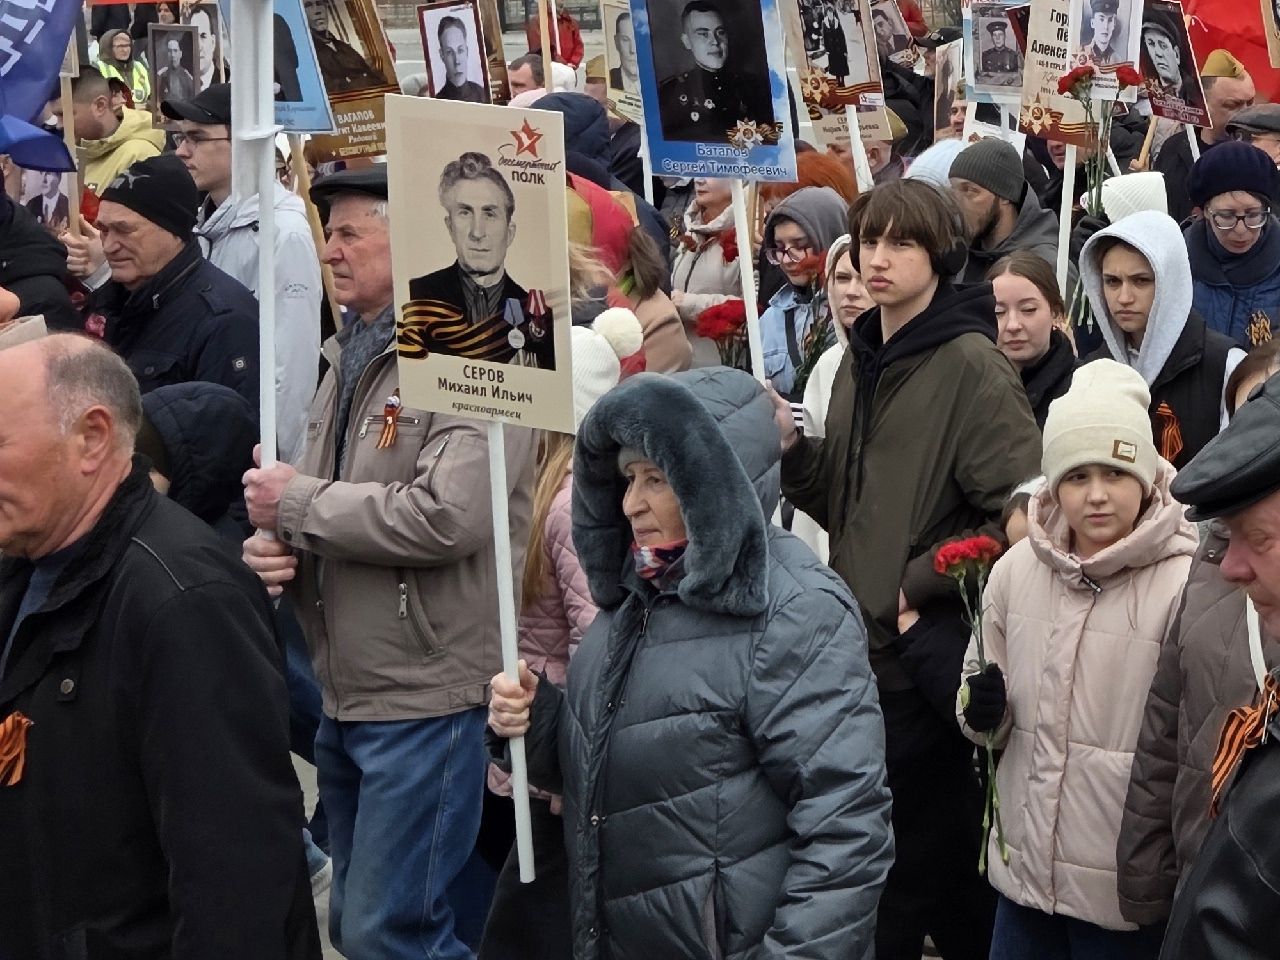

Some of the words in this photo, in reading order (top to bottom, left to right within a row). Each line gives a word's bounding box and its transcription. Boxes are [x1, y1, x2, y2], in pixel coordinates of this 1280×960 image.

[1050, 8, 1069, 28] Гор
[1056, 27, 1069, 42] Пе
[1030, 39, 1067, 60] Алекса
[336, 109, 375, 124] ВАГАПОВ
[662, 158, 706, 174] Сергей
[709, 160, 788, 177] Тимофеевич
[511, 170, 546, 186] ПОЛК
[463, 364, 505, 384] СЕРОВ
[437, 376, 487, 397] Михаил
[491, 384, 533, 405] Ильич
